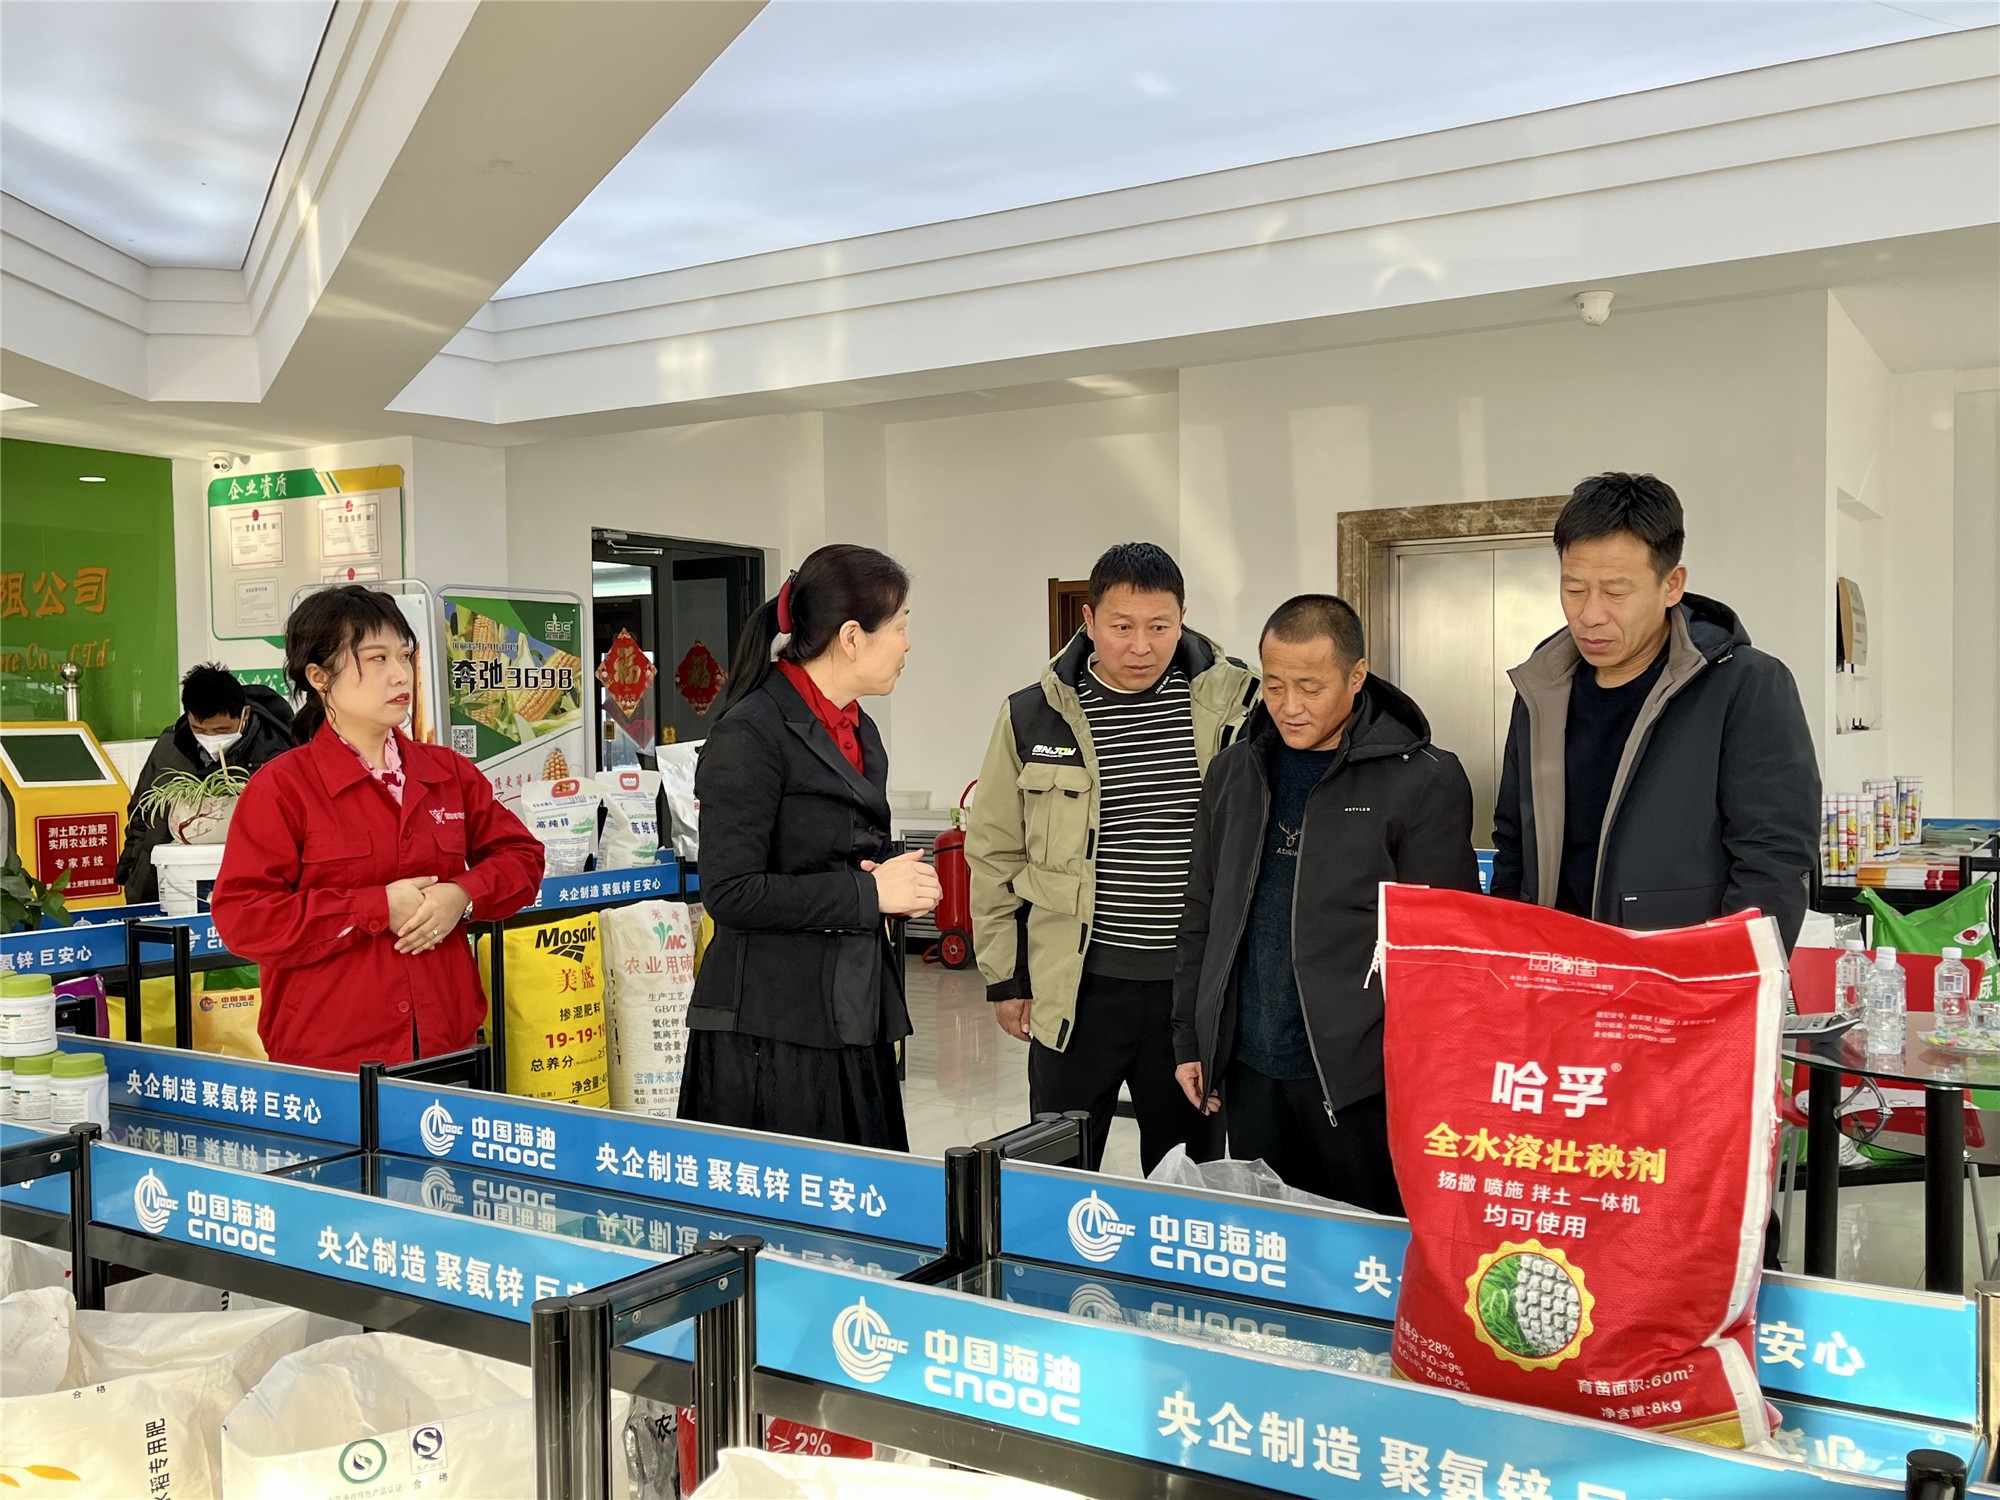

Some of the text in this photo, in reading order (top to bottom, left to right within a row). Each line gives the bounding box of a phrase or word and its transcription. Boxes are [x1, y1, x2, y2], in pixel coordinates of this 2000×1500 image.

[48, 824, 108, 838] 测土配方施肥
[536, 817, 569, 829] 高纯锌
[48, 836, 108, 851] 实用农业技术
[55, 855, 104, 870] 专家系统
[559, 884, 599, 902] 央企制造
[602, 880, 631, 896] 聚氨锌
[633, 878, 661, 893] 巨安心
[535, 921, 597, 949] Mosaic
[40, 945, 93, 967] 巨安心
[557, 966, 597, 995] 美盛
[560, 1002, 600, 1021] 掺混肥料
[530, 1055, 574, 1072] 总养分
[665, 1054, 686, 1064] 净含
[127, 1070, 322, 1126] 央企制造 聚氨锌 巨安心
[1491, 1060, 1609, 1119] 哈孚
[471, 1116, 556, 1151] 中国海油
[471, 1141, 556, 1170] CNOOC
[1423, 1122, 1668, 1184] 全水溶壮秧剂
[596, 1142, 887, 1218] 央企制造 聚氨锌 巨安心
[1437, 1170, 1641, 1215] 扬撒 喷施 拌土 一体机
[187, 1190, 276, 1232] 中国海油
[1483, 1203, 1587, 1239] 均可使用
[188, 1218, 276, 1256] CNOOC
[1150, 1214, 1287, 1263] 中国海油
[317, 1225, 427, 1284] 央企制造
[436, 1250, 525, 1307] 聚氨锌
[1150, 1246, 1287, 1288] CNOOC
[925, 1329, 1080, 1394] 中国海油
[925, 1365, 1080, 1425] CNOOC
[1157, 1390, 1362, 1481] 央企制造
